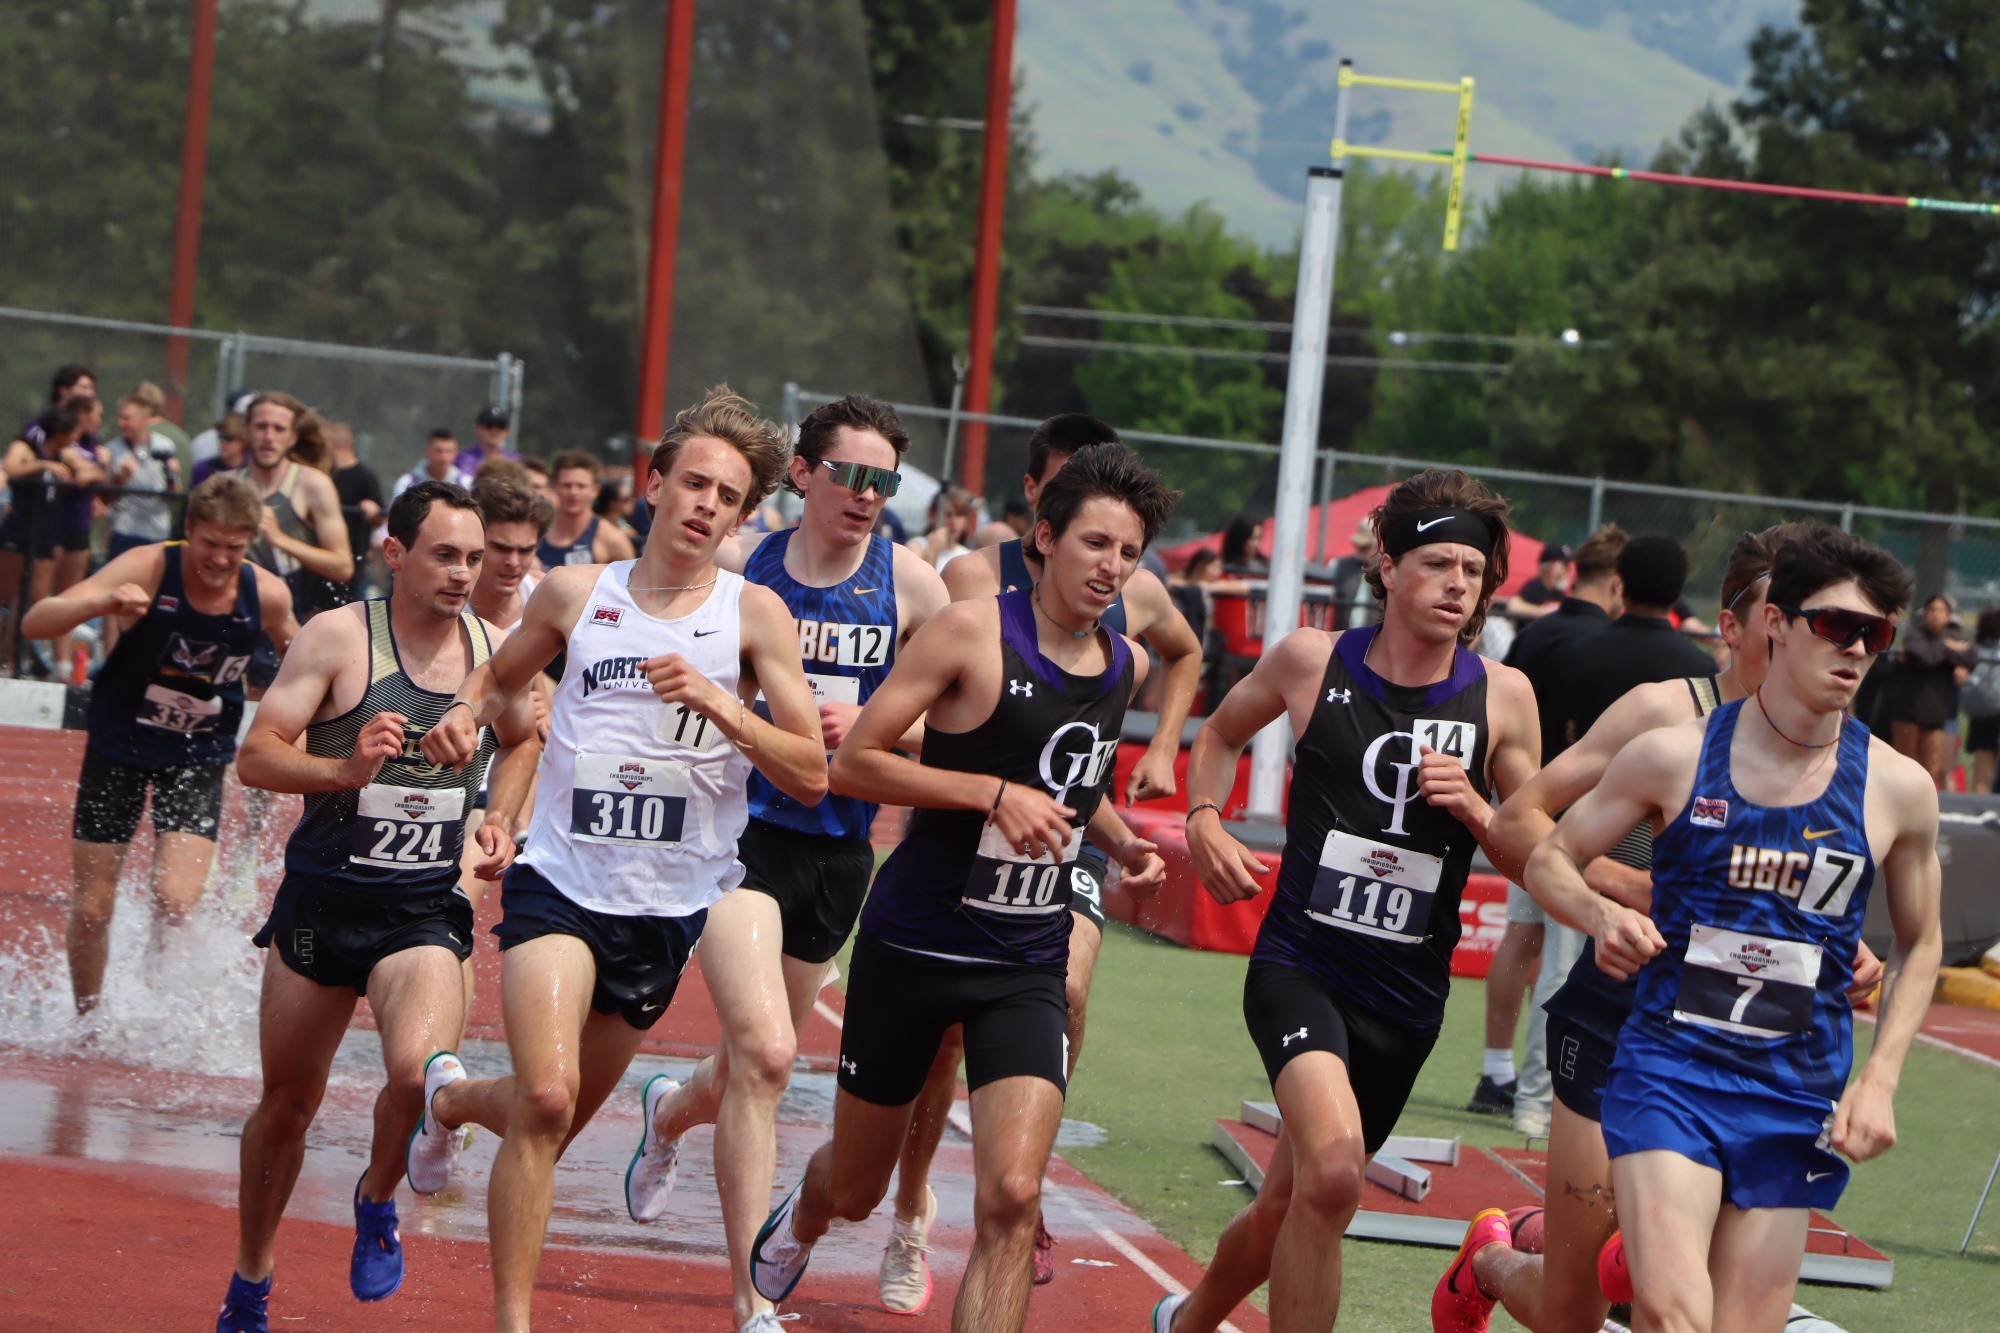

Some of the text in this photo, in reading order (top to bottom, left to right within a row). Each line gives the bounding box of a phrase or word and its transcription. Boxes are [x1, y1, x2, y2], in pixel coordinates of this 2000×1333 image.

[797, 618, 883, 664] BC 12
[222, 658, 244, 682] 6
[603, 681, 654, 690] UNIVE
[151, 703, 205, 729] 337
[674, 704, 708, 748] 11
[1424, 723, 1464, 758] 14
[609, 773, 653, 781] CHAMPIONSHIPS
[394, 802, 435, 811] CHAMPIONSHIPS
[590, 792, 665, 840] 310
[370, 820, 442, 862] 224
[1360, 856, 1405, 873] CHAMPIONSHIPS
[1728, 844, 1855, 911] UBC 7
[987, 863, 1060, 906] 110
[1331, 875, 1413, 932] 119
[293, 928, 313, 964] E
[1729, 952, 1780, 966] CHAMPIONSHIPS
[1729, 976, 1764, 1024] 7
[1559, 1035, 1580, 1080] E
